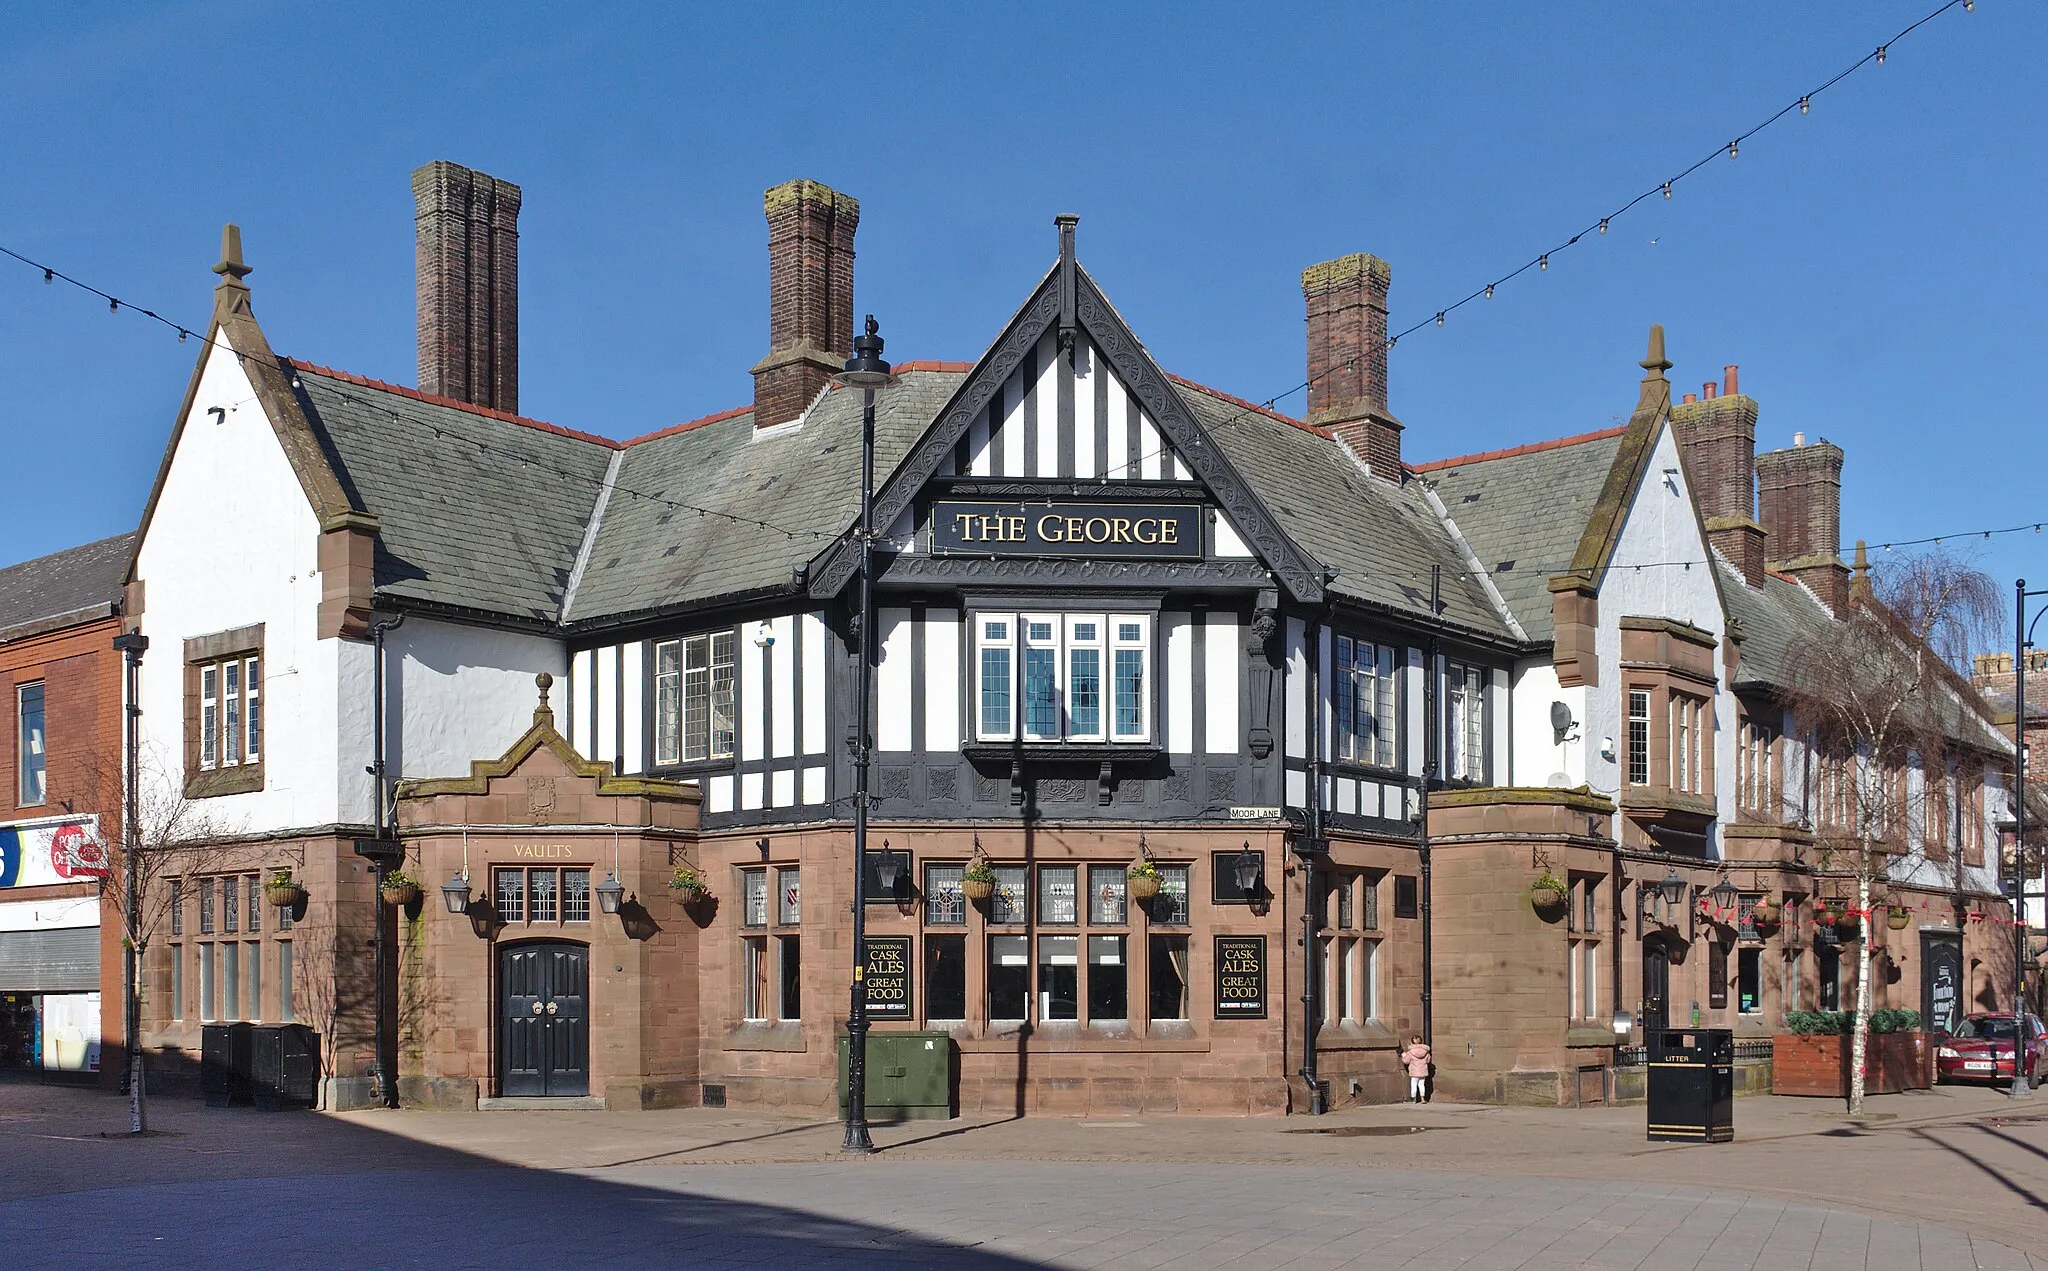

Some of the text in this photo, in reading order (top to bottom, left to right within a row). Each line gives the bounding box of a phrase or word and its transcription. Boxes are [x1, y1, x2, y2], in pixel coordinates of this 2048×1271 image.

[956, 514, 1178, 544] THE GEORGE
[514, 844, 572, 857] VAULTS
[870, 950, 900, 960] CASK
[1225, 949, 1255, 959] CASK
[866, 961, 905, 974] ALES
[1222, 960, 1259, 973] ALES
[867, 978, 904, 988] GREAT
[1222, 977, 1258, 987] GREAT
[867, 988, 904, 999] FOOD
[1222, 987, 1258, 998] FOOD
